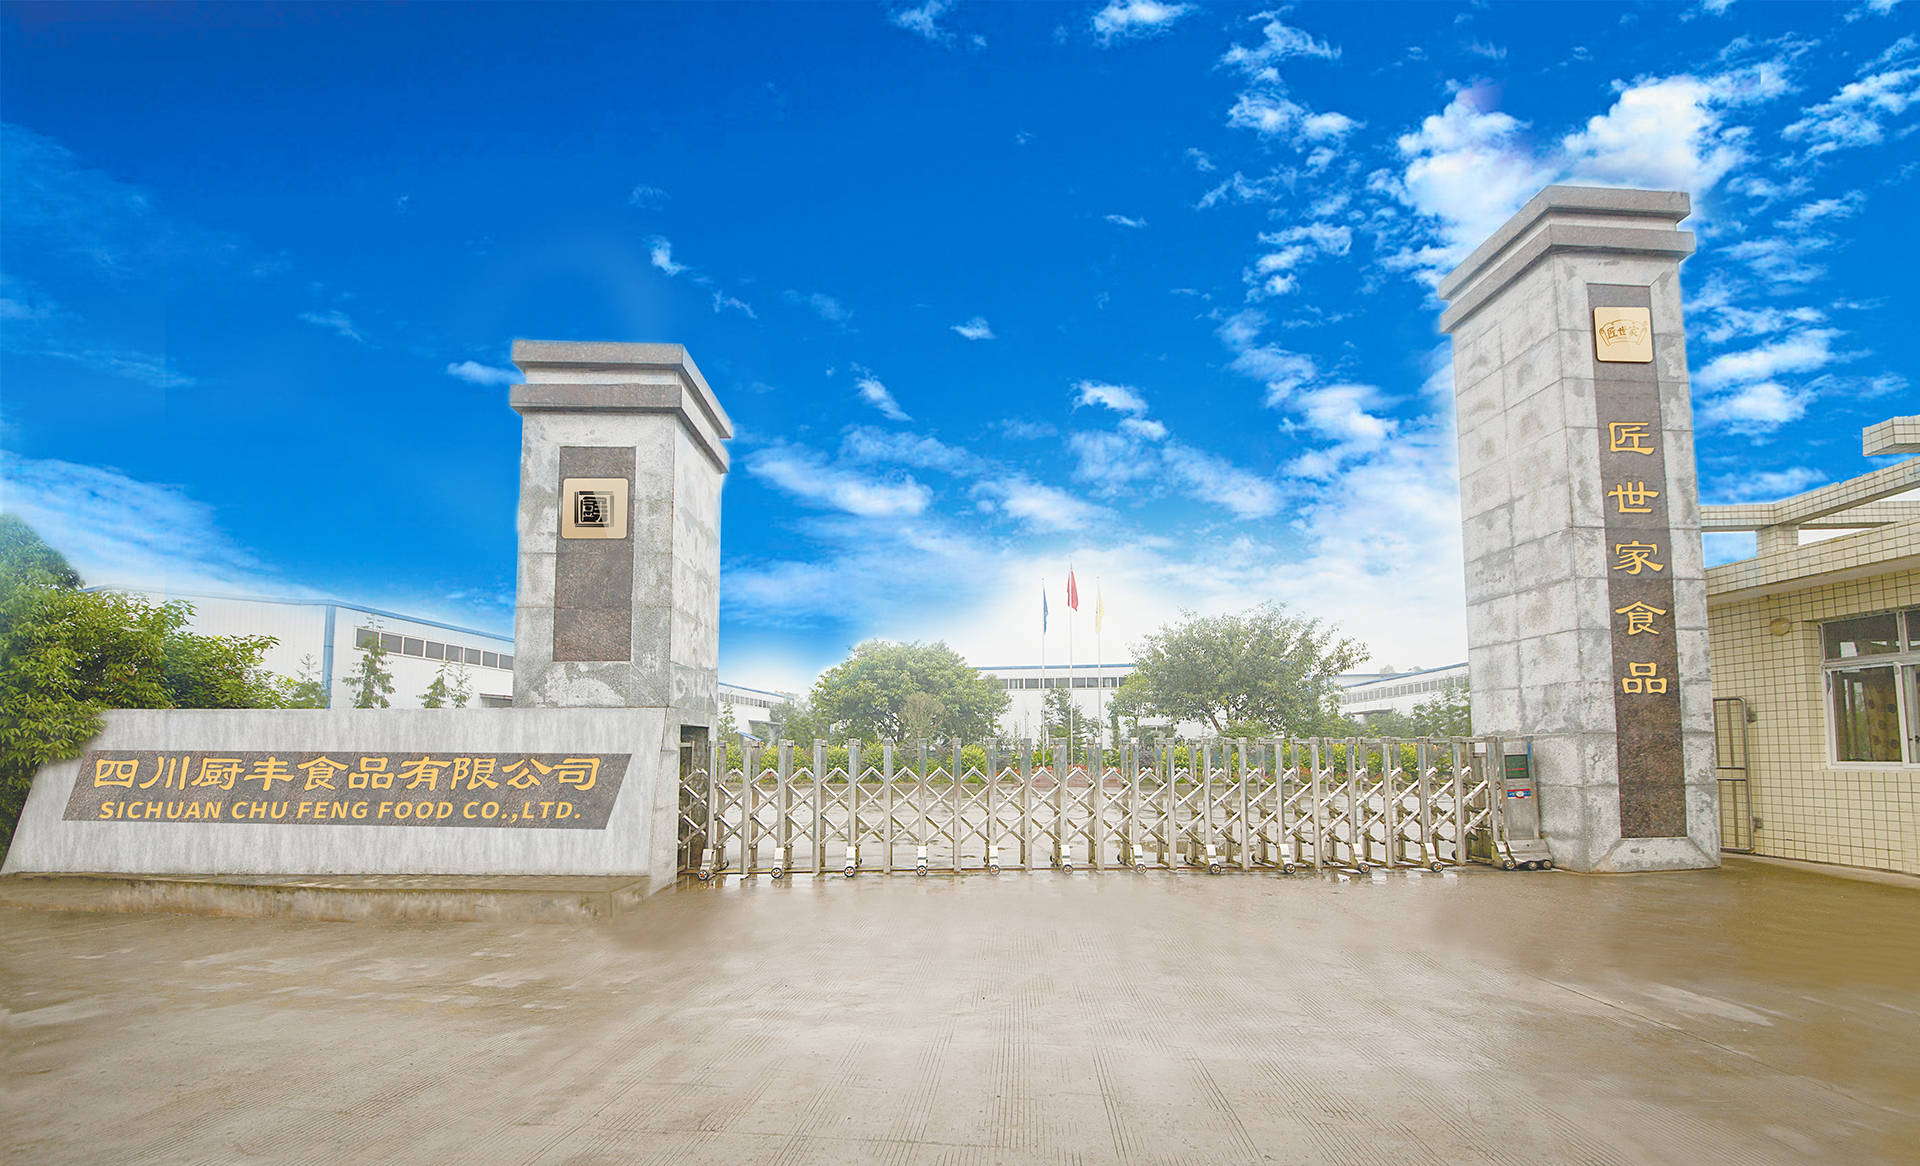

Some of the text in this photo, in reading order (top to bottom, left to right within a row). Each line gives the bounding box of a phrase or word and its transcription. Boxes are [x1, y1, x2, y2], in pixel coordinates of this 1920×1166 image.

[1607, 422, 1667, 694] 匠世家食品
[93, 756, 601, 792] 四川厨丰食品有限公司
[98, 800, 581, 823] SICHUAN CHU FENG FOOD CO.,LTD.
